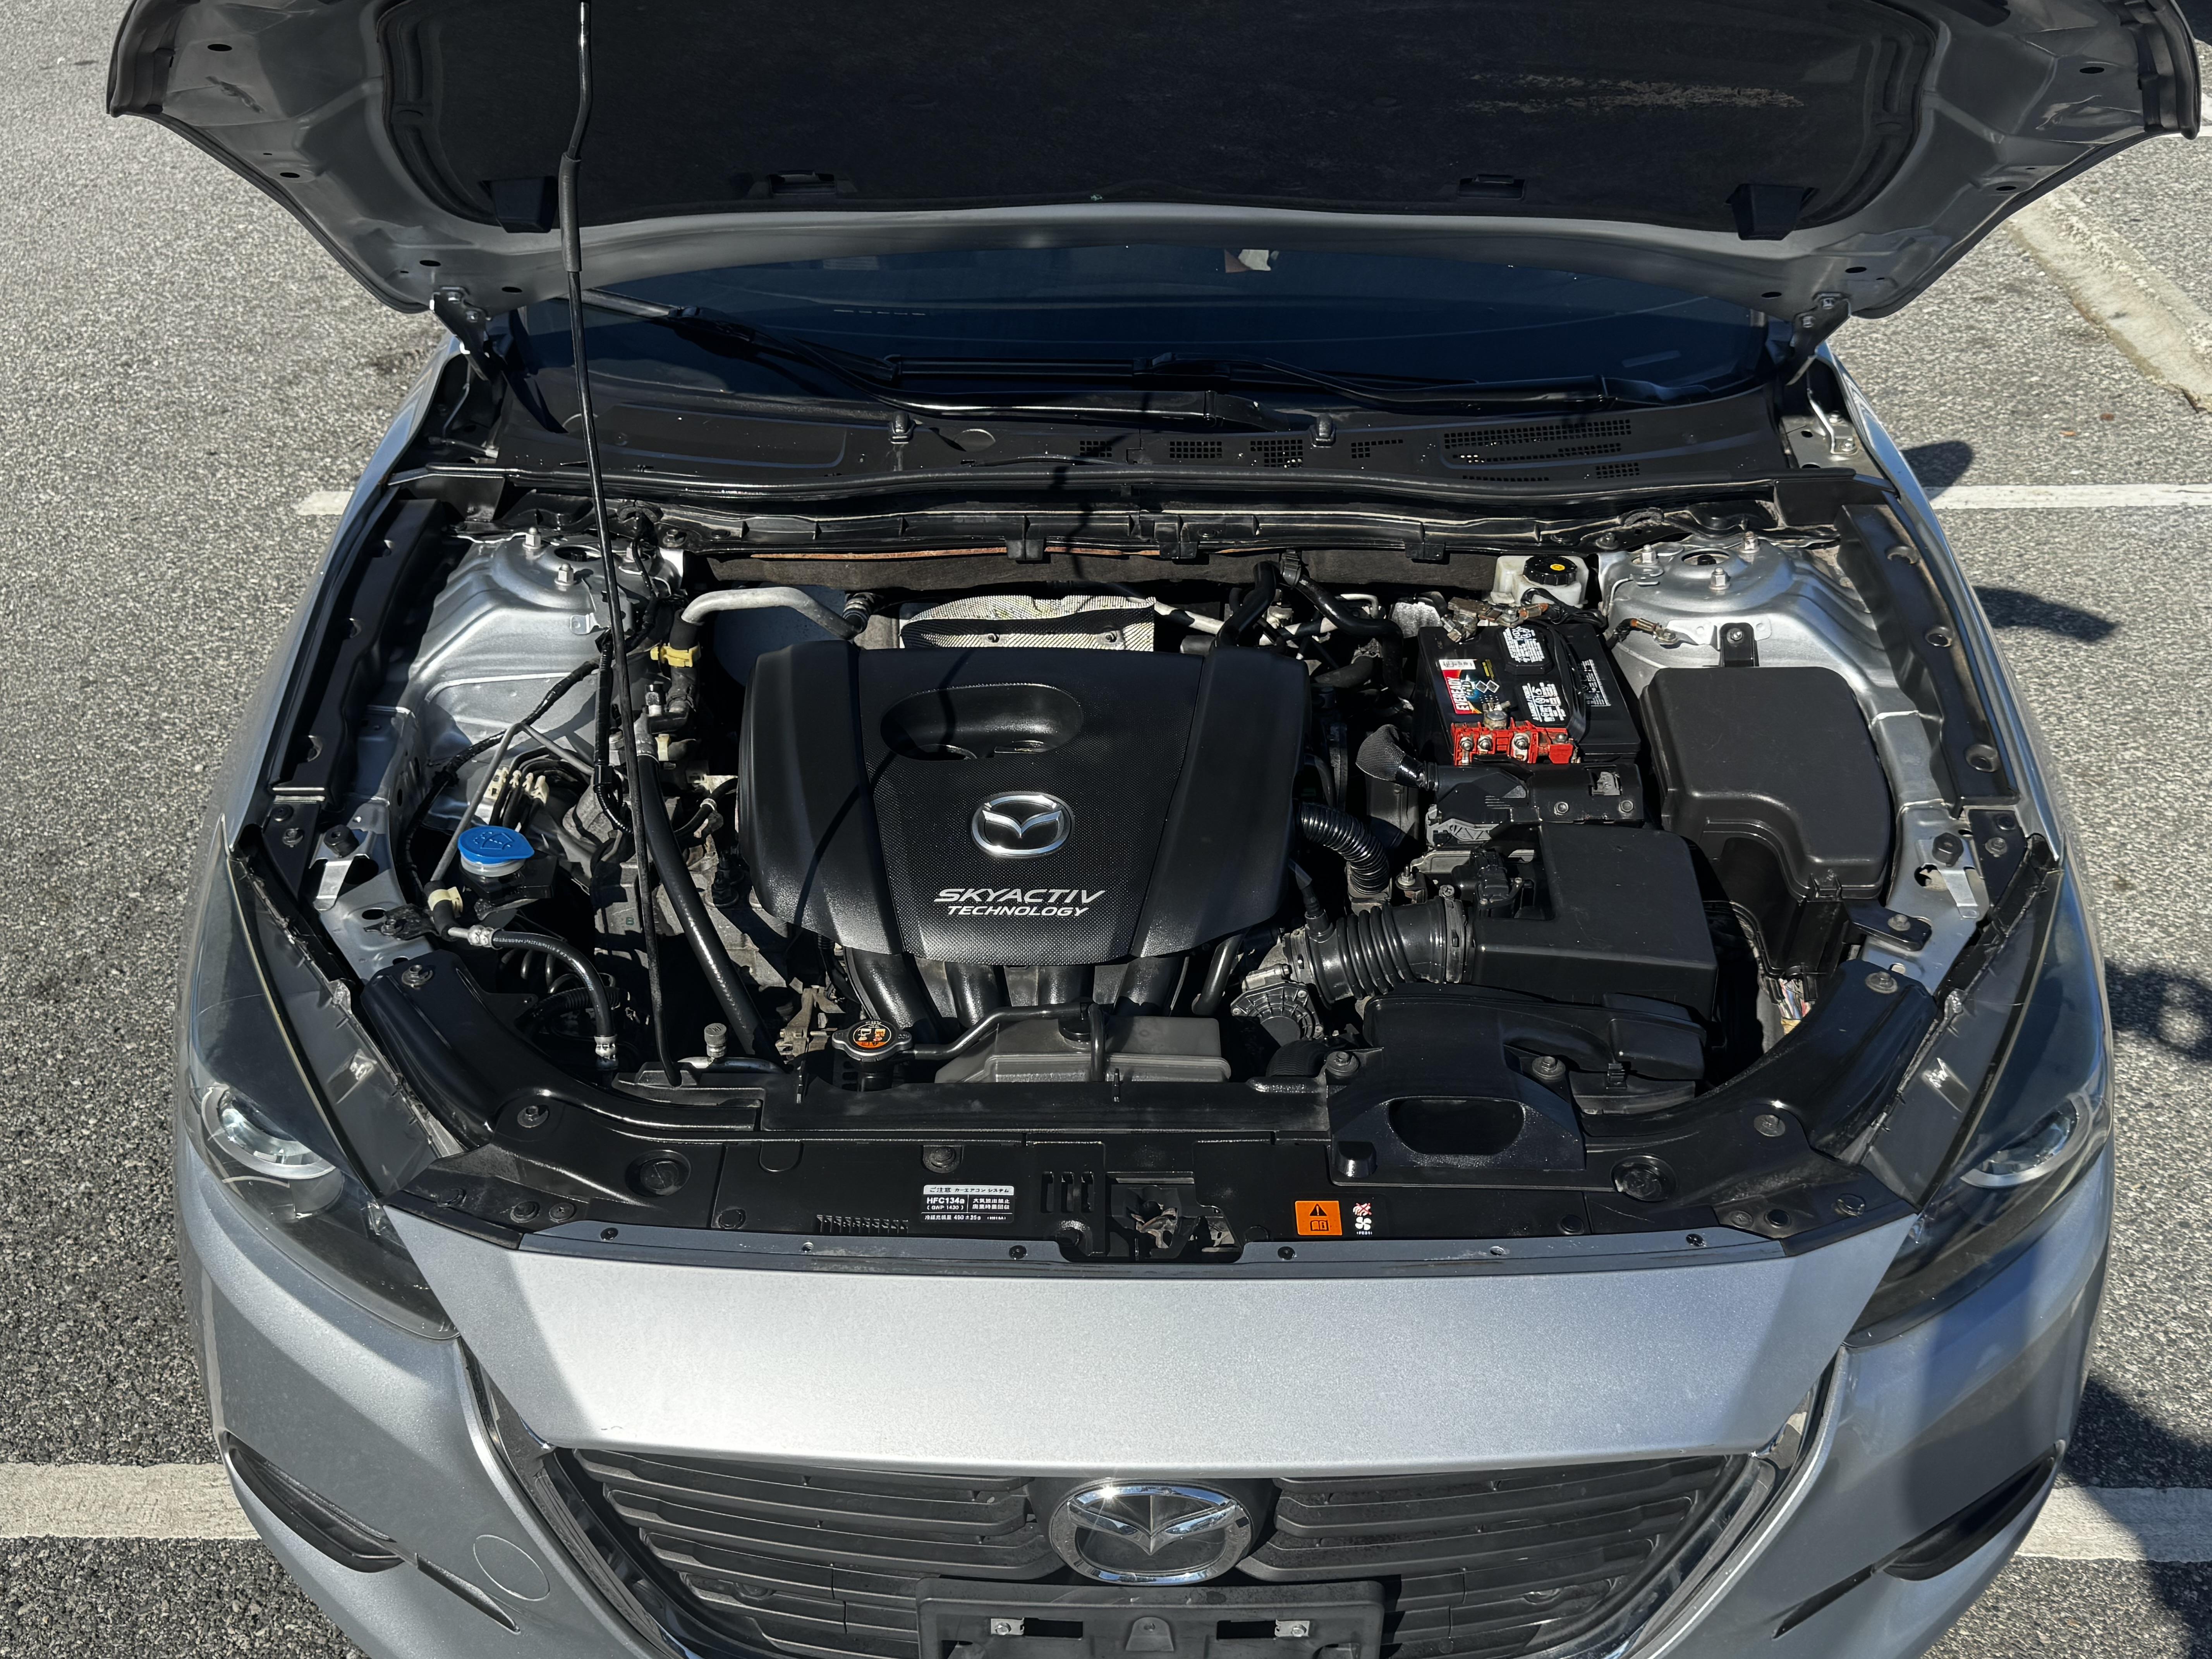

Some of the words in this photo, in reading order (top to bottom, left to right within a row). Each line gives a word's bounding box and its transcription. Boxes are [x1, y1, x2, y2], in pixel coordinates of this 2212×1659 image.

[1447, 677, 1470, 711] EVEREADY
[934, 888, 1105, 903] SKYACTIV
[948, 906, 1089, 916] TECHNOLOGY
